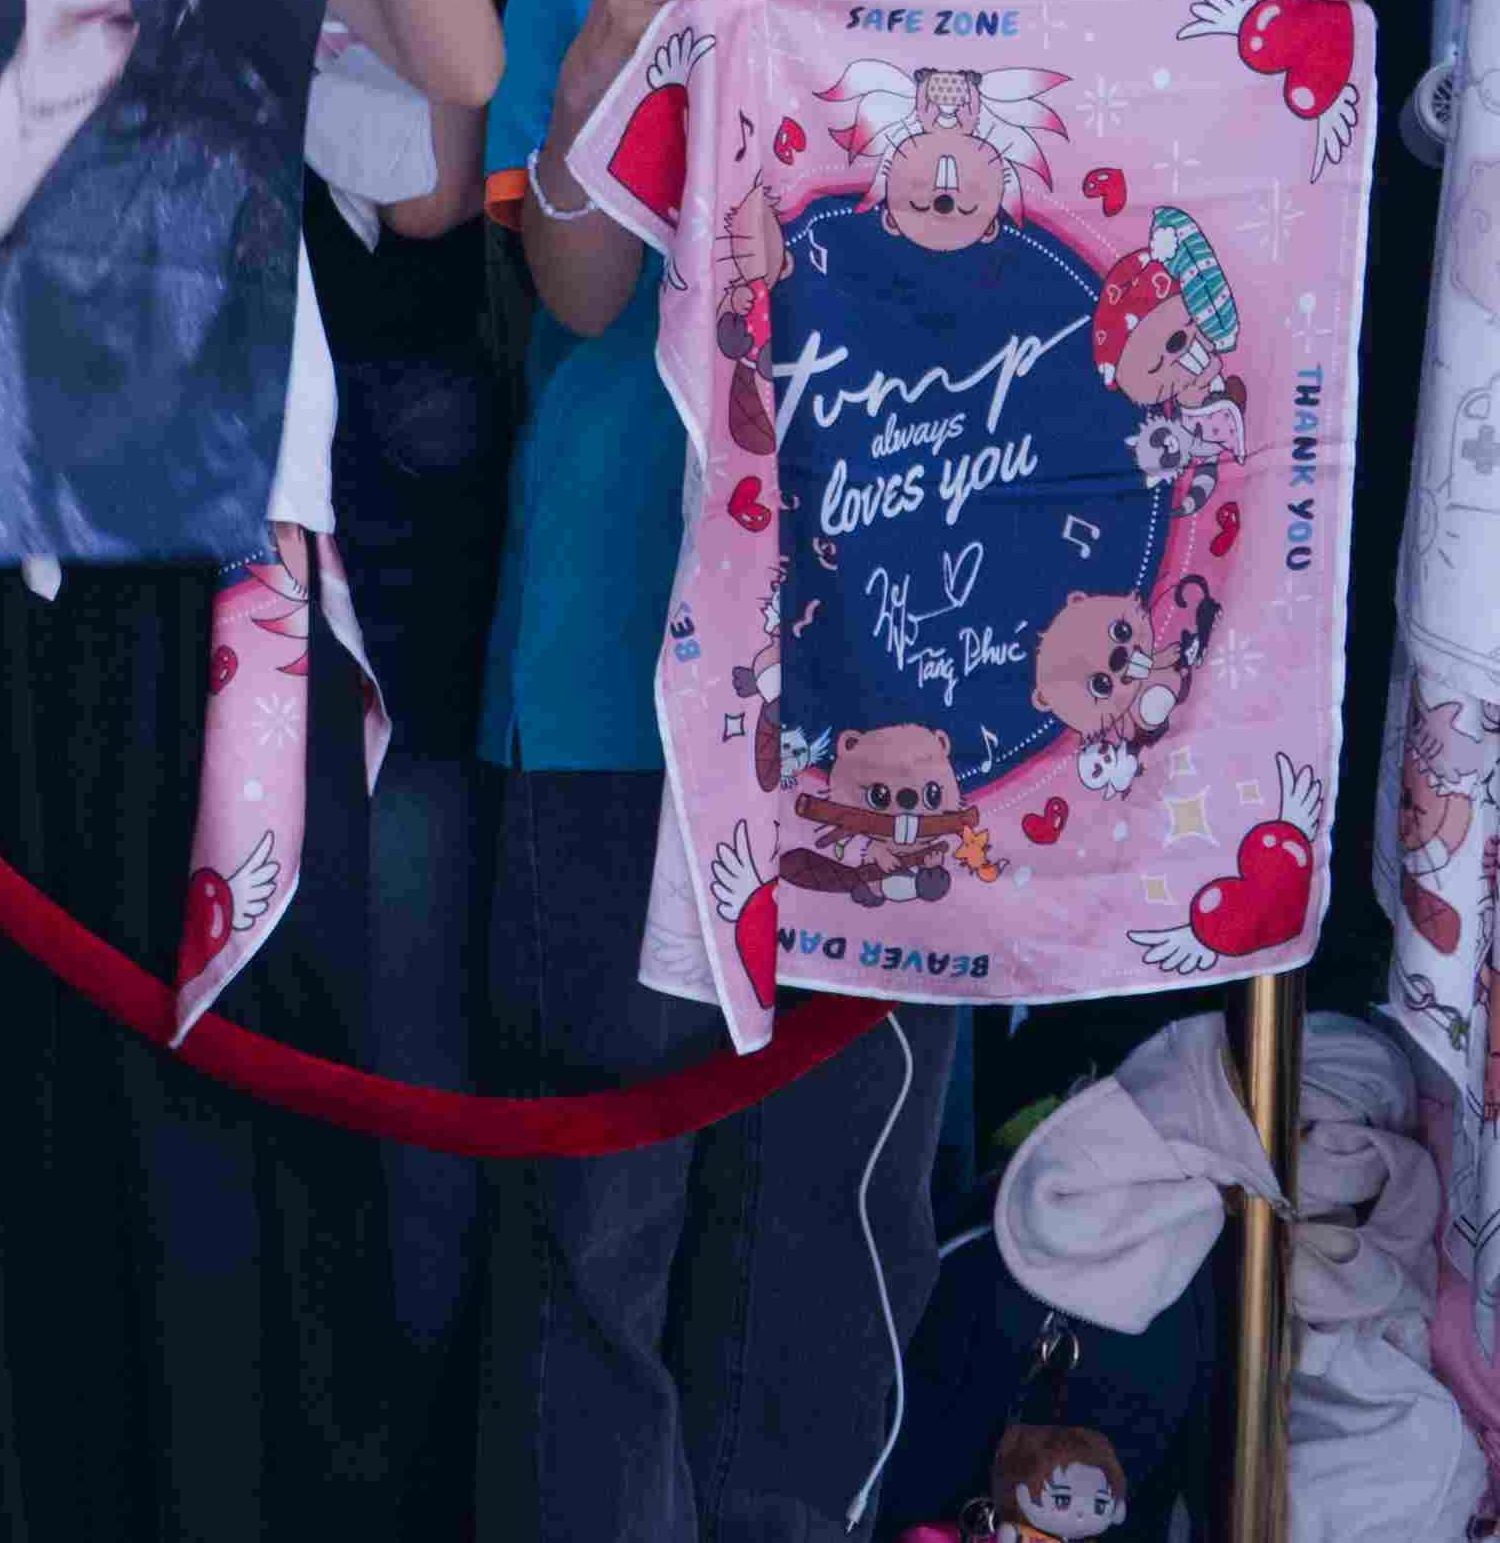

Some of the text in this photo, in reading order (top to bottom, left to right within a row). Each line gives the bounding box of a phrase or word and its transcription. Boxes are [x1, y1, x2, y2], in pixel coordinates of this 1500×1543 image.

[846, 6, 1021, 37] SAFE ZONE
[871, 412, 966, 458] always
[940, 434, 1039, 526] you
[1286, 362, 1324, 571] THANK YOU
[859, 939, 990, 980] BEAVER
